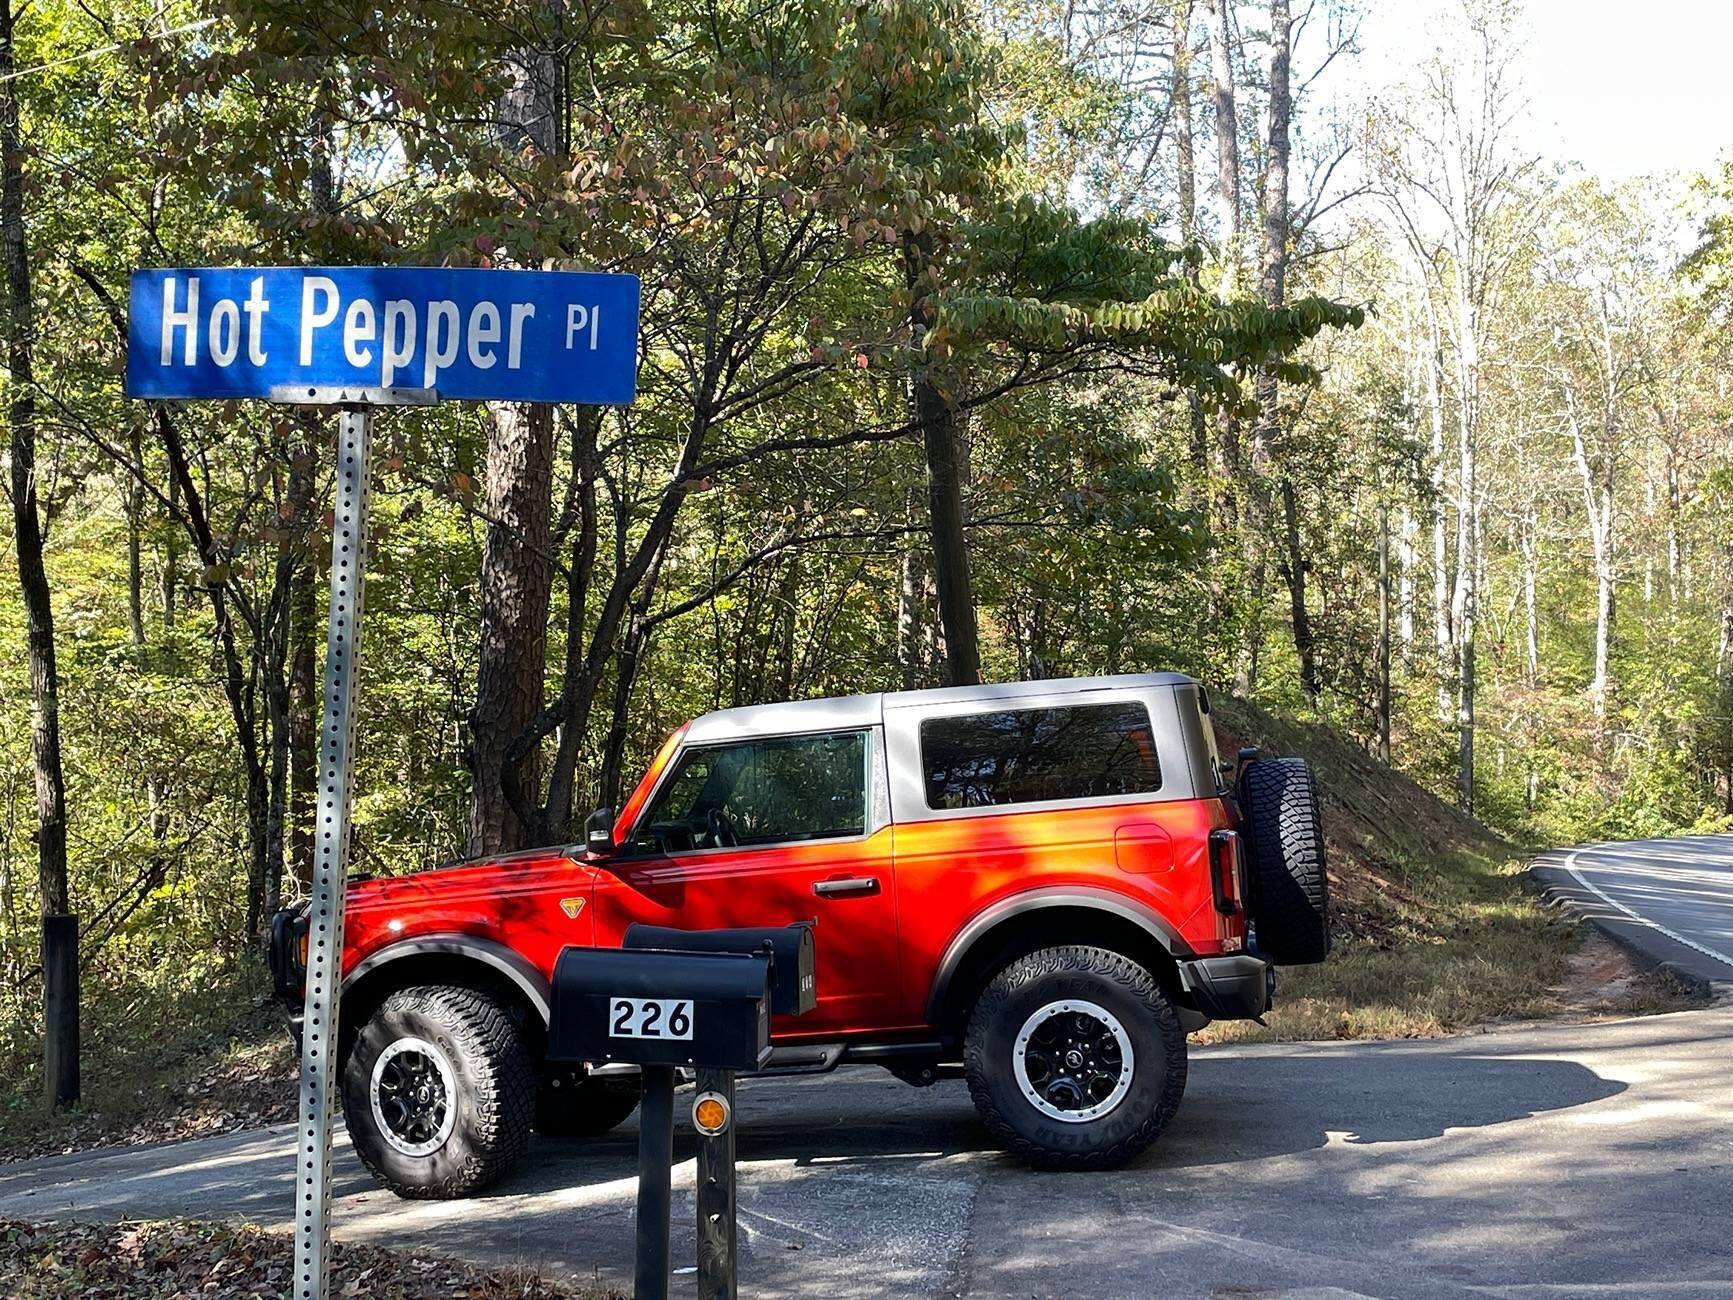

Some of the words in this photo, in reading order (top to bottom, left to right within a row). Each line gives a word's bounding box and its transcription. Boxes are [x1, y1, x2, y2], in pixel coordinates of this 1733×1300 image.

[160, 276, 270, 367] Hot
[300, 276, 536, 389] Pepper
[565, 304, 600, 351] Pl
[613, 1001, 690, 1036] 226
